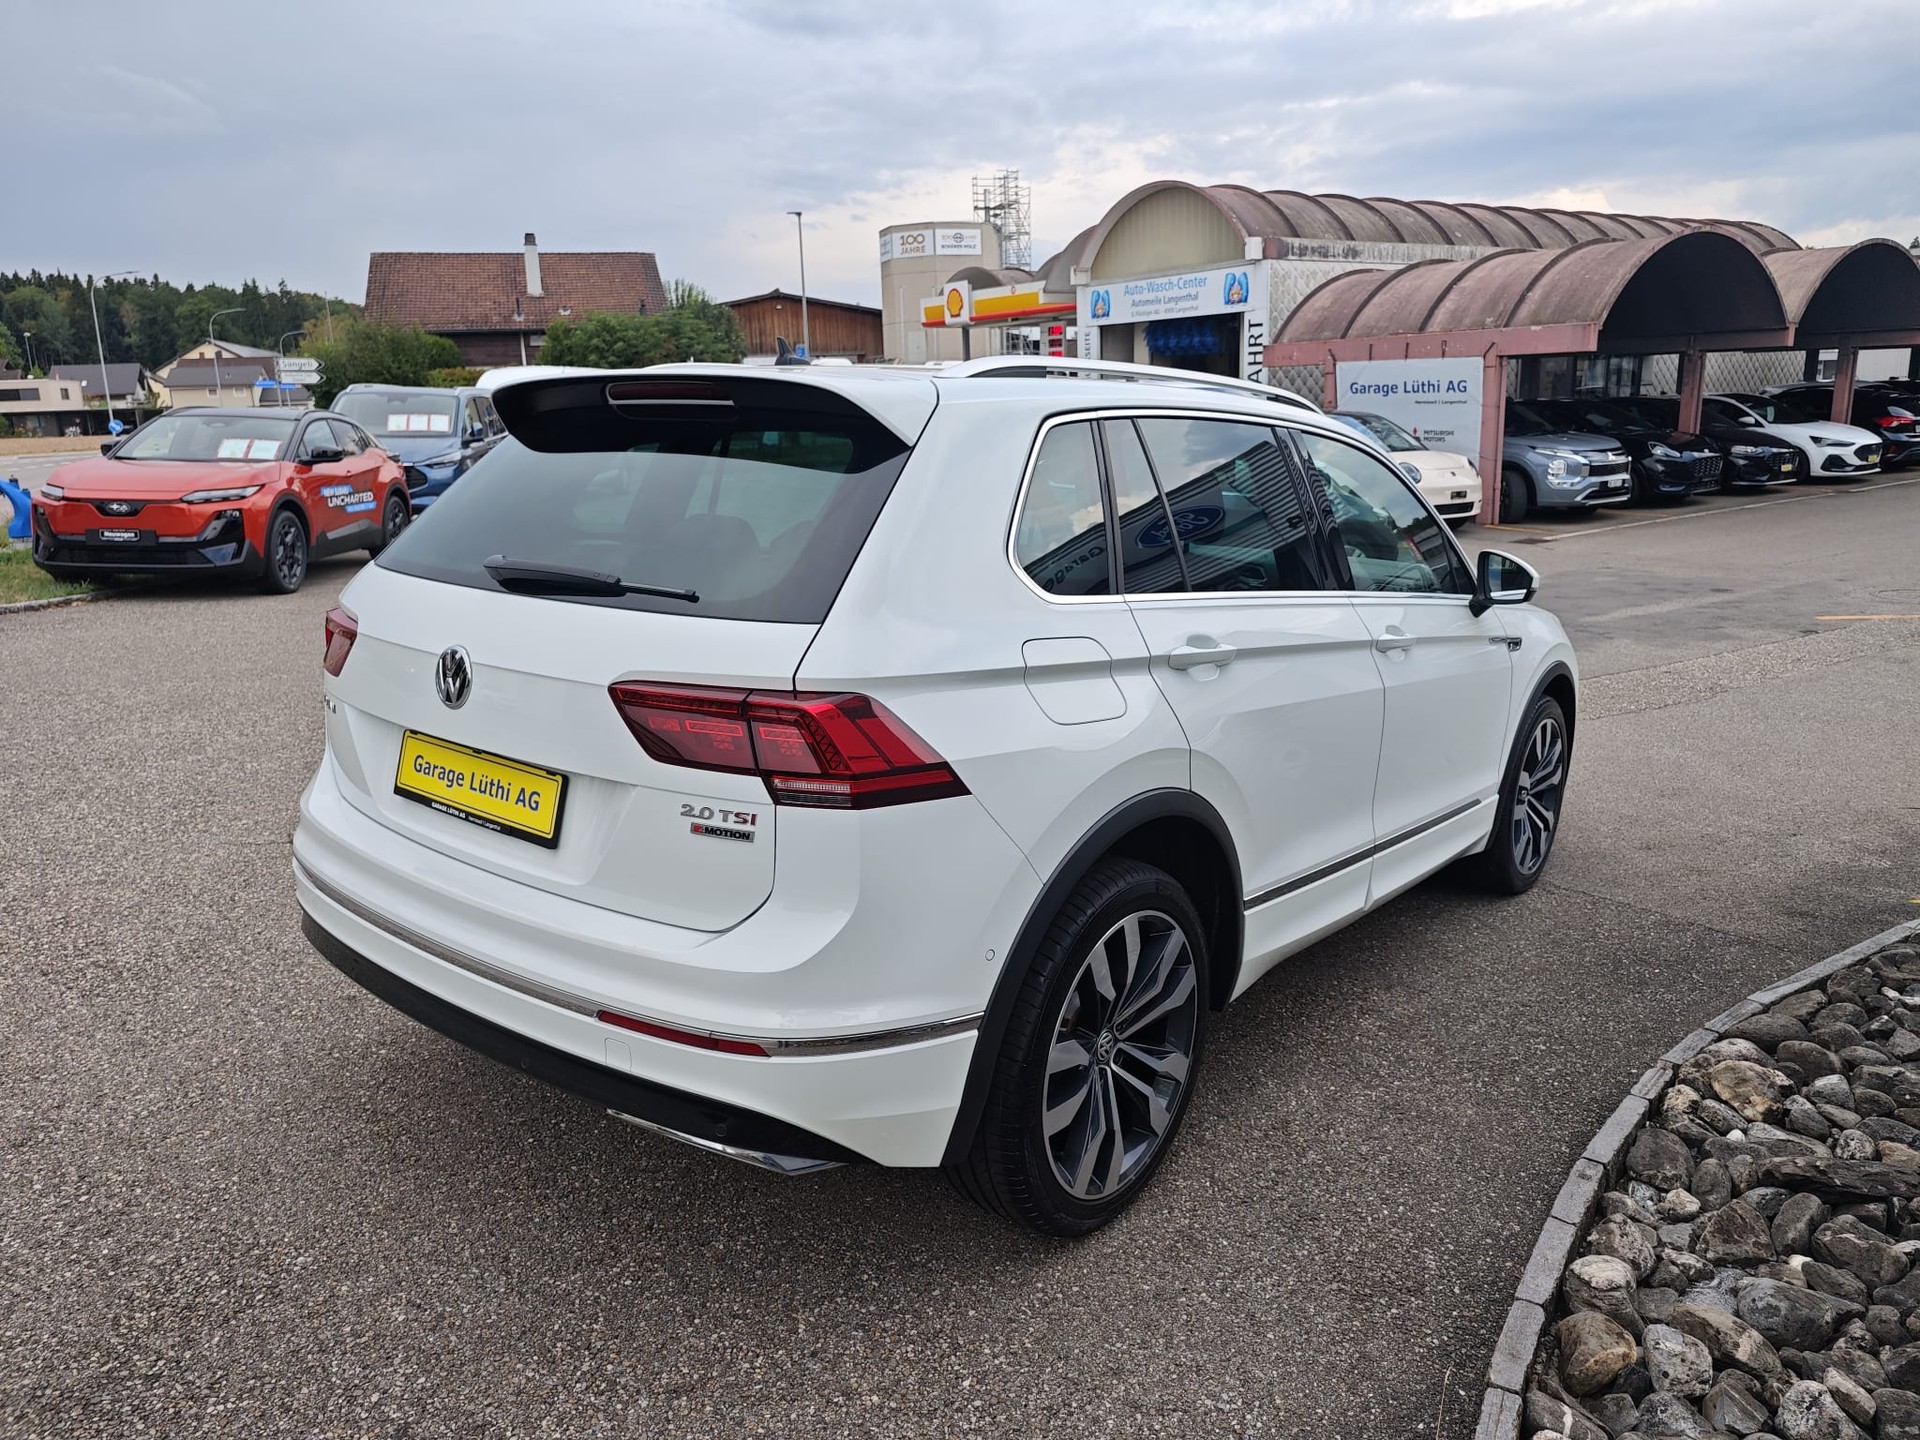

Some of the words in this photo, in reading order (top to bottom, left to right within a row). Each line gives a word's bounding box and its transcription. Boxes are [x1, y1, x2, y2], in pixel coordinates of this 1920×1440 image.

[900, 234, 925, 246] 100
[900, 246, 926, 255] JAHRE
[1123, 276, 1208, 297] Auto-Wasch-Center
[1163, 291, 1199, 306] Langenthal
[1350, 382, 1398, 397] Garage
[1403, 380, 1441, 394] Lüthi
[1446, 380, 1468, 393] AG
[328, 491, 374, 507] UNCHARTED
[413, 755, 465, 788] Garage
[469, 772, 512, 802] Lüthi
[515, 787, 541, 812] AG
[719, 809, 758, 827] TSI
